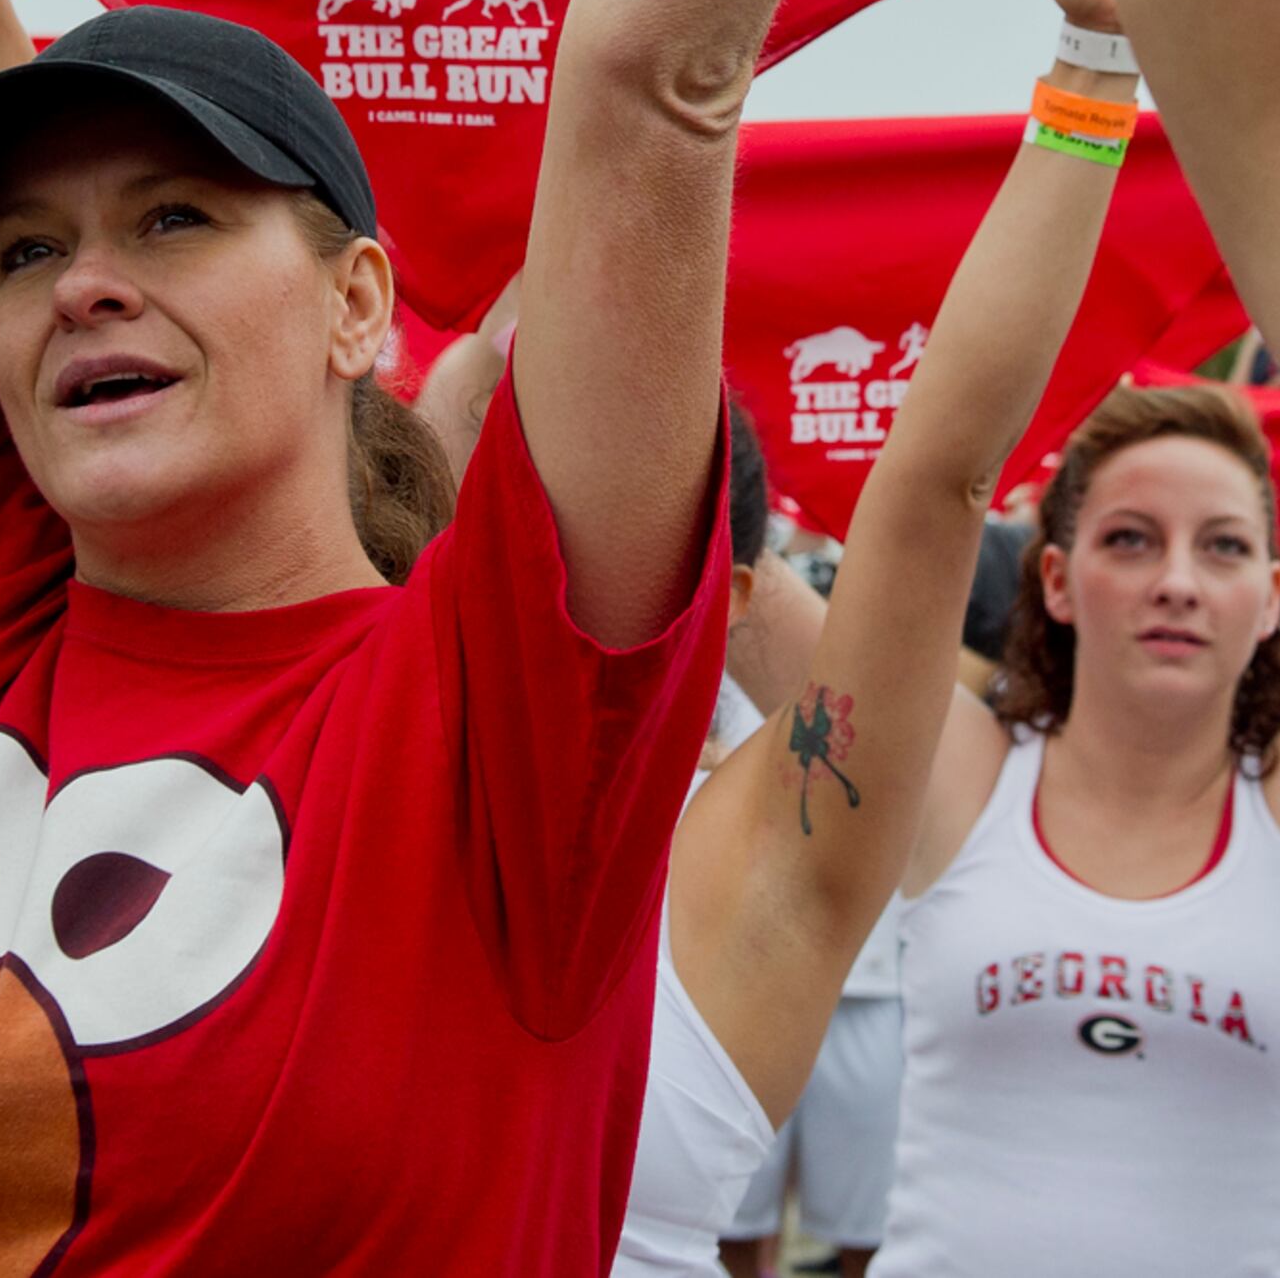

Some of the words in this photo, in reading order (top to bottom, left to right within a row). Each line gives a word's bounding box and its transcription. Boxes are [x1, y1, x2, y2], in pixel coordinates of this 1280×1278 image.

[318, 24, 405, 58] THE
[412, 25, 549, 61] GREAT
[320, 62, 438, 100] BULL
[445, 65, 549, 104] RUN
[790, 382, 861, 411] THE
[790, 410, 886, 443] BULL
[975, 951, 1258, 1047] GEORGIA
[1077, 1013, 1142, 1057] G
